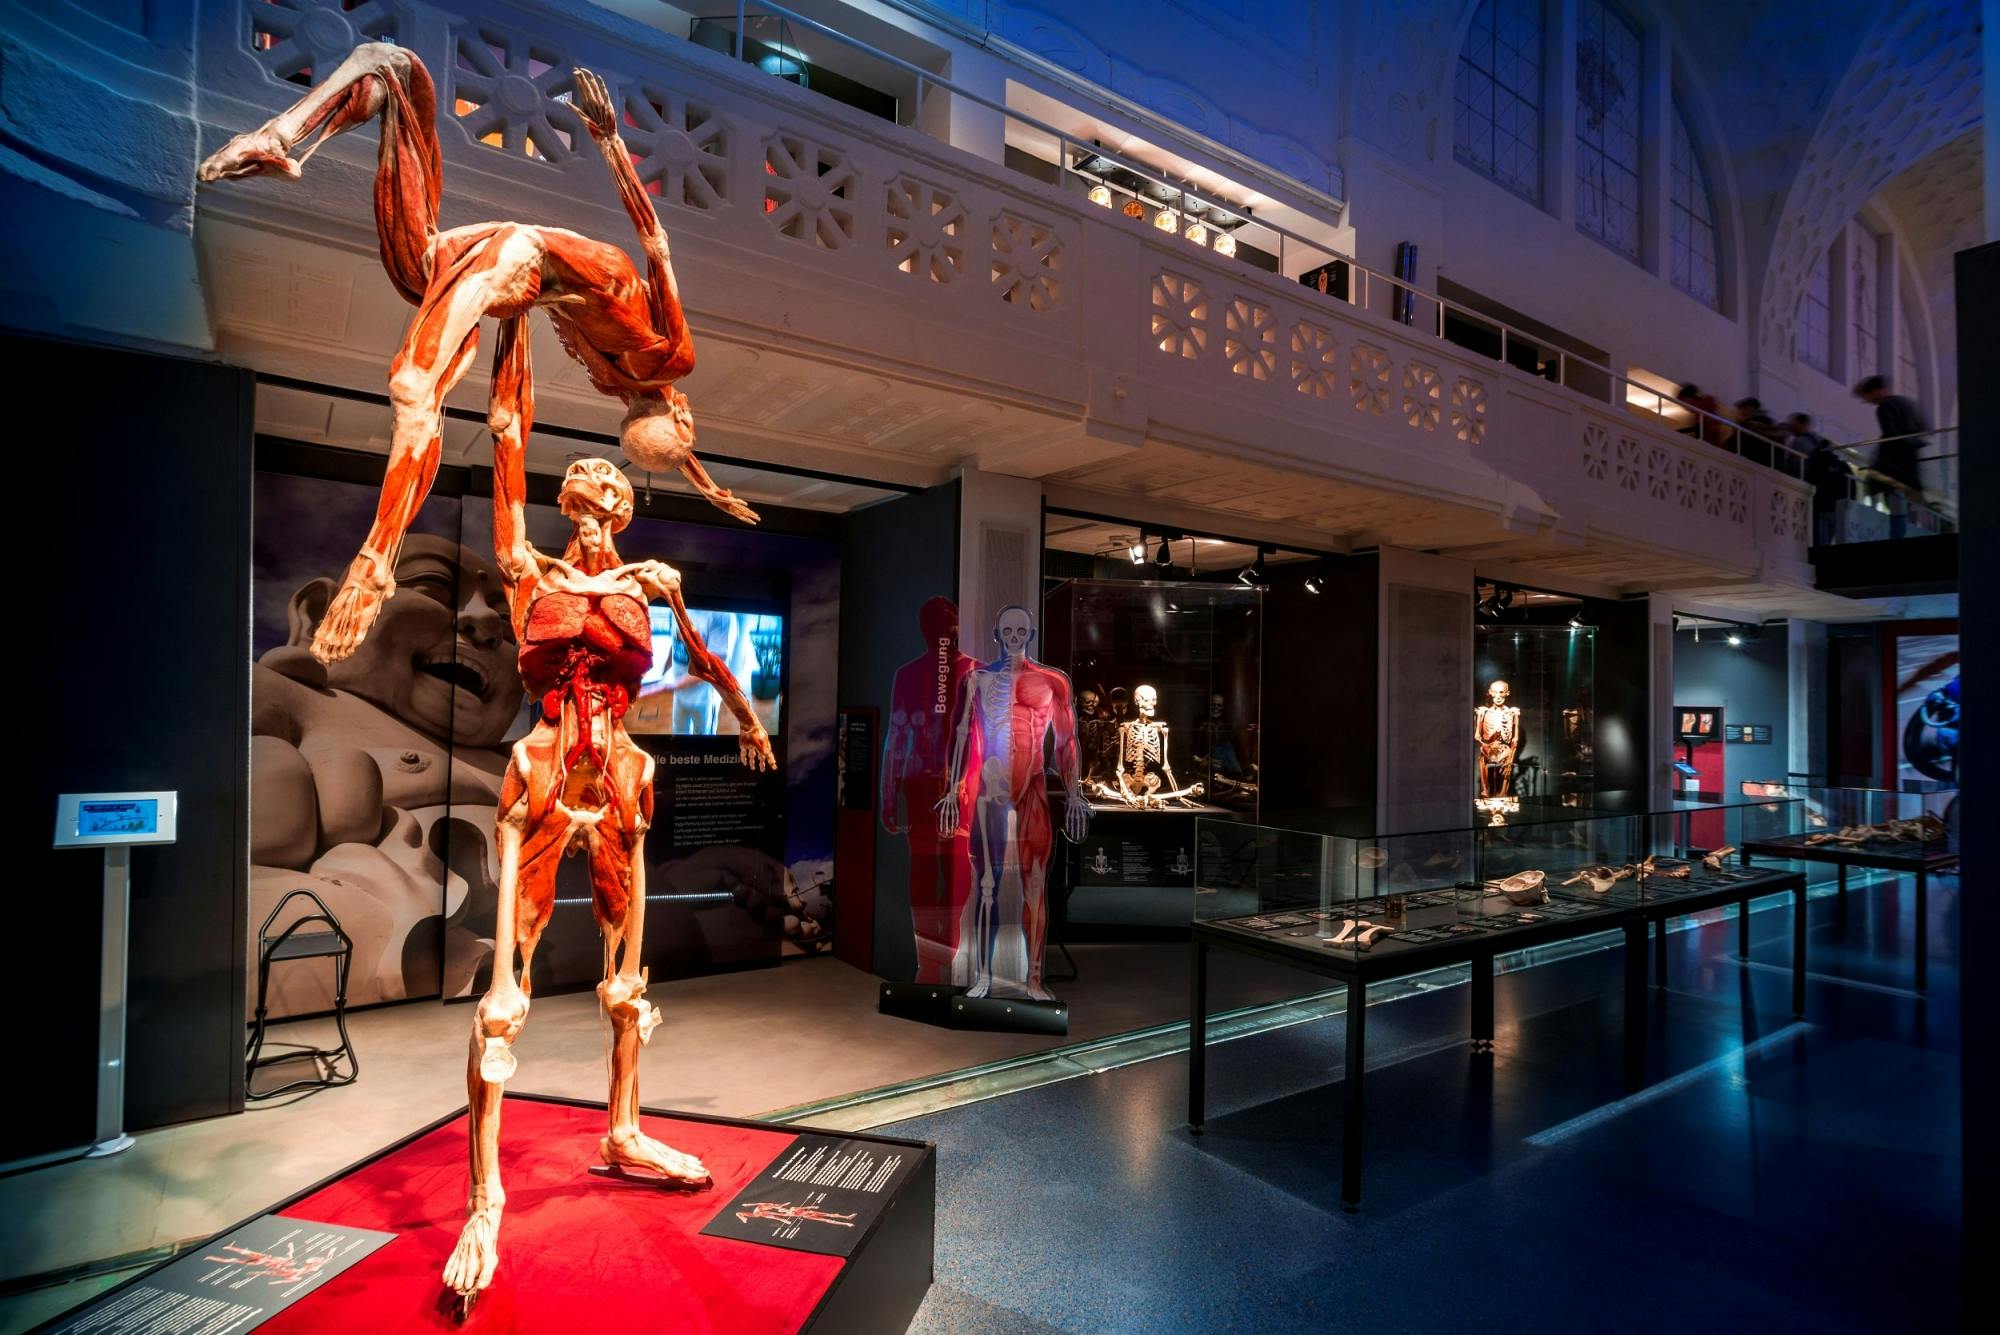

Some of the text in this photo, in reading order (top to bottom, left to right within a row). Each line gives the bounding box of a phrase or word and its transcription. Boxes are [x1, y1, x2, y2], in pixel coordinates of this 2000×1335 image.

[934, 637, 950, 714] Bewegung
[654, 753, 741, 765] ie beste Medizi
